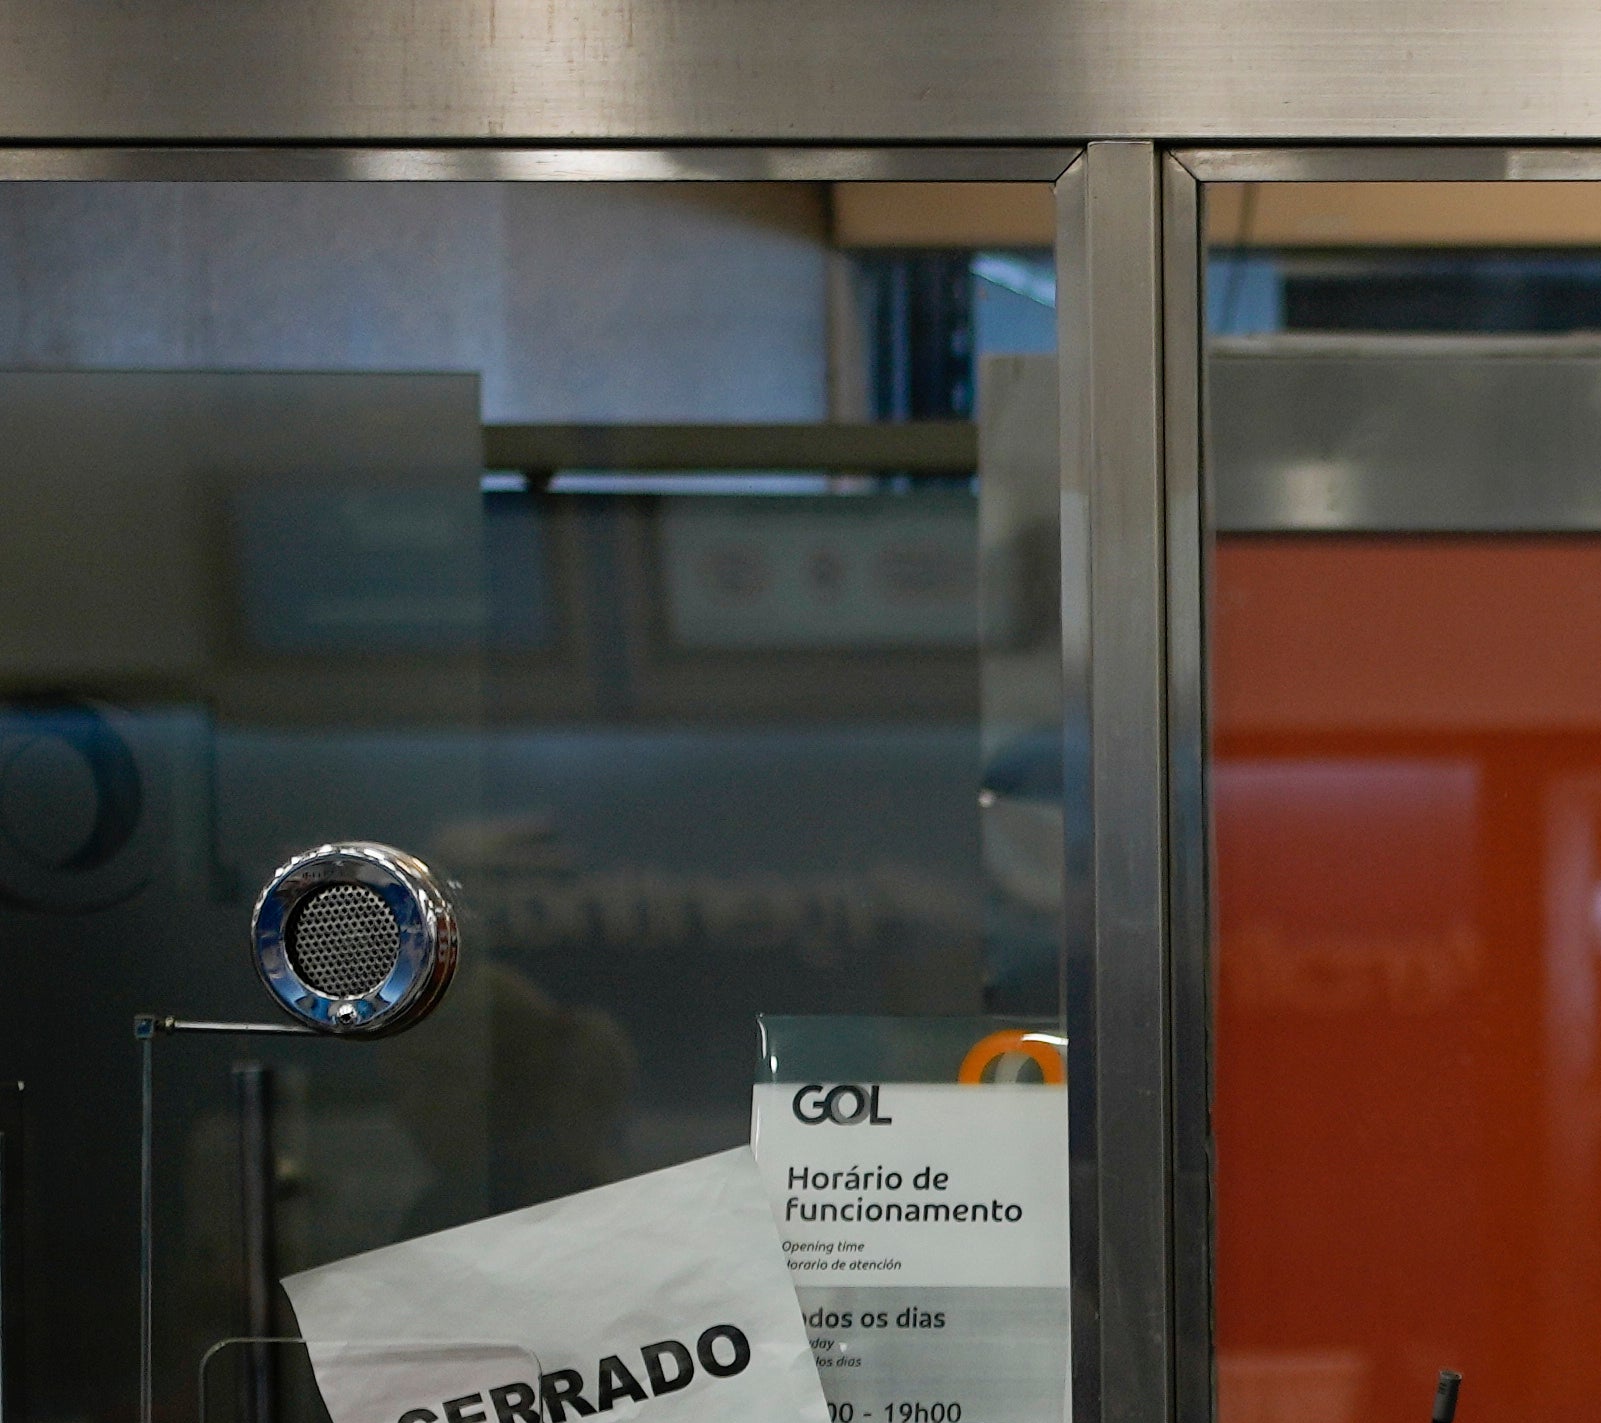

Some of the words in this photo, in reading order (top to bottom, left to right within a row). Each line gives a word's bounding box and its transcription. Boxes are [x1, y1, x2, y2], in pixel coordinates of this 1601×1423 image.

[792, 1084, 893, 1126] GOL
[787, 1165, 903, 1191] Horário
[912, 1166, 949, 1191] de
[784, 1197, 1023, 1223] funcionamento
[782, 1240, 834, 1255] Opening
[837, 1240, 865, 1253] time
[831, 1258, 846, 1271] de
[849, 1258, 902, 1271] atención
[801, 1306, 853, 1329] dos
[860, 1311, 888, 1329] os
[895, 1306, 946, 1329] dias
